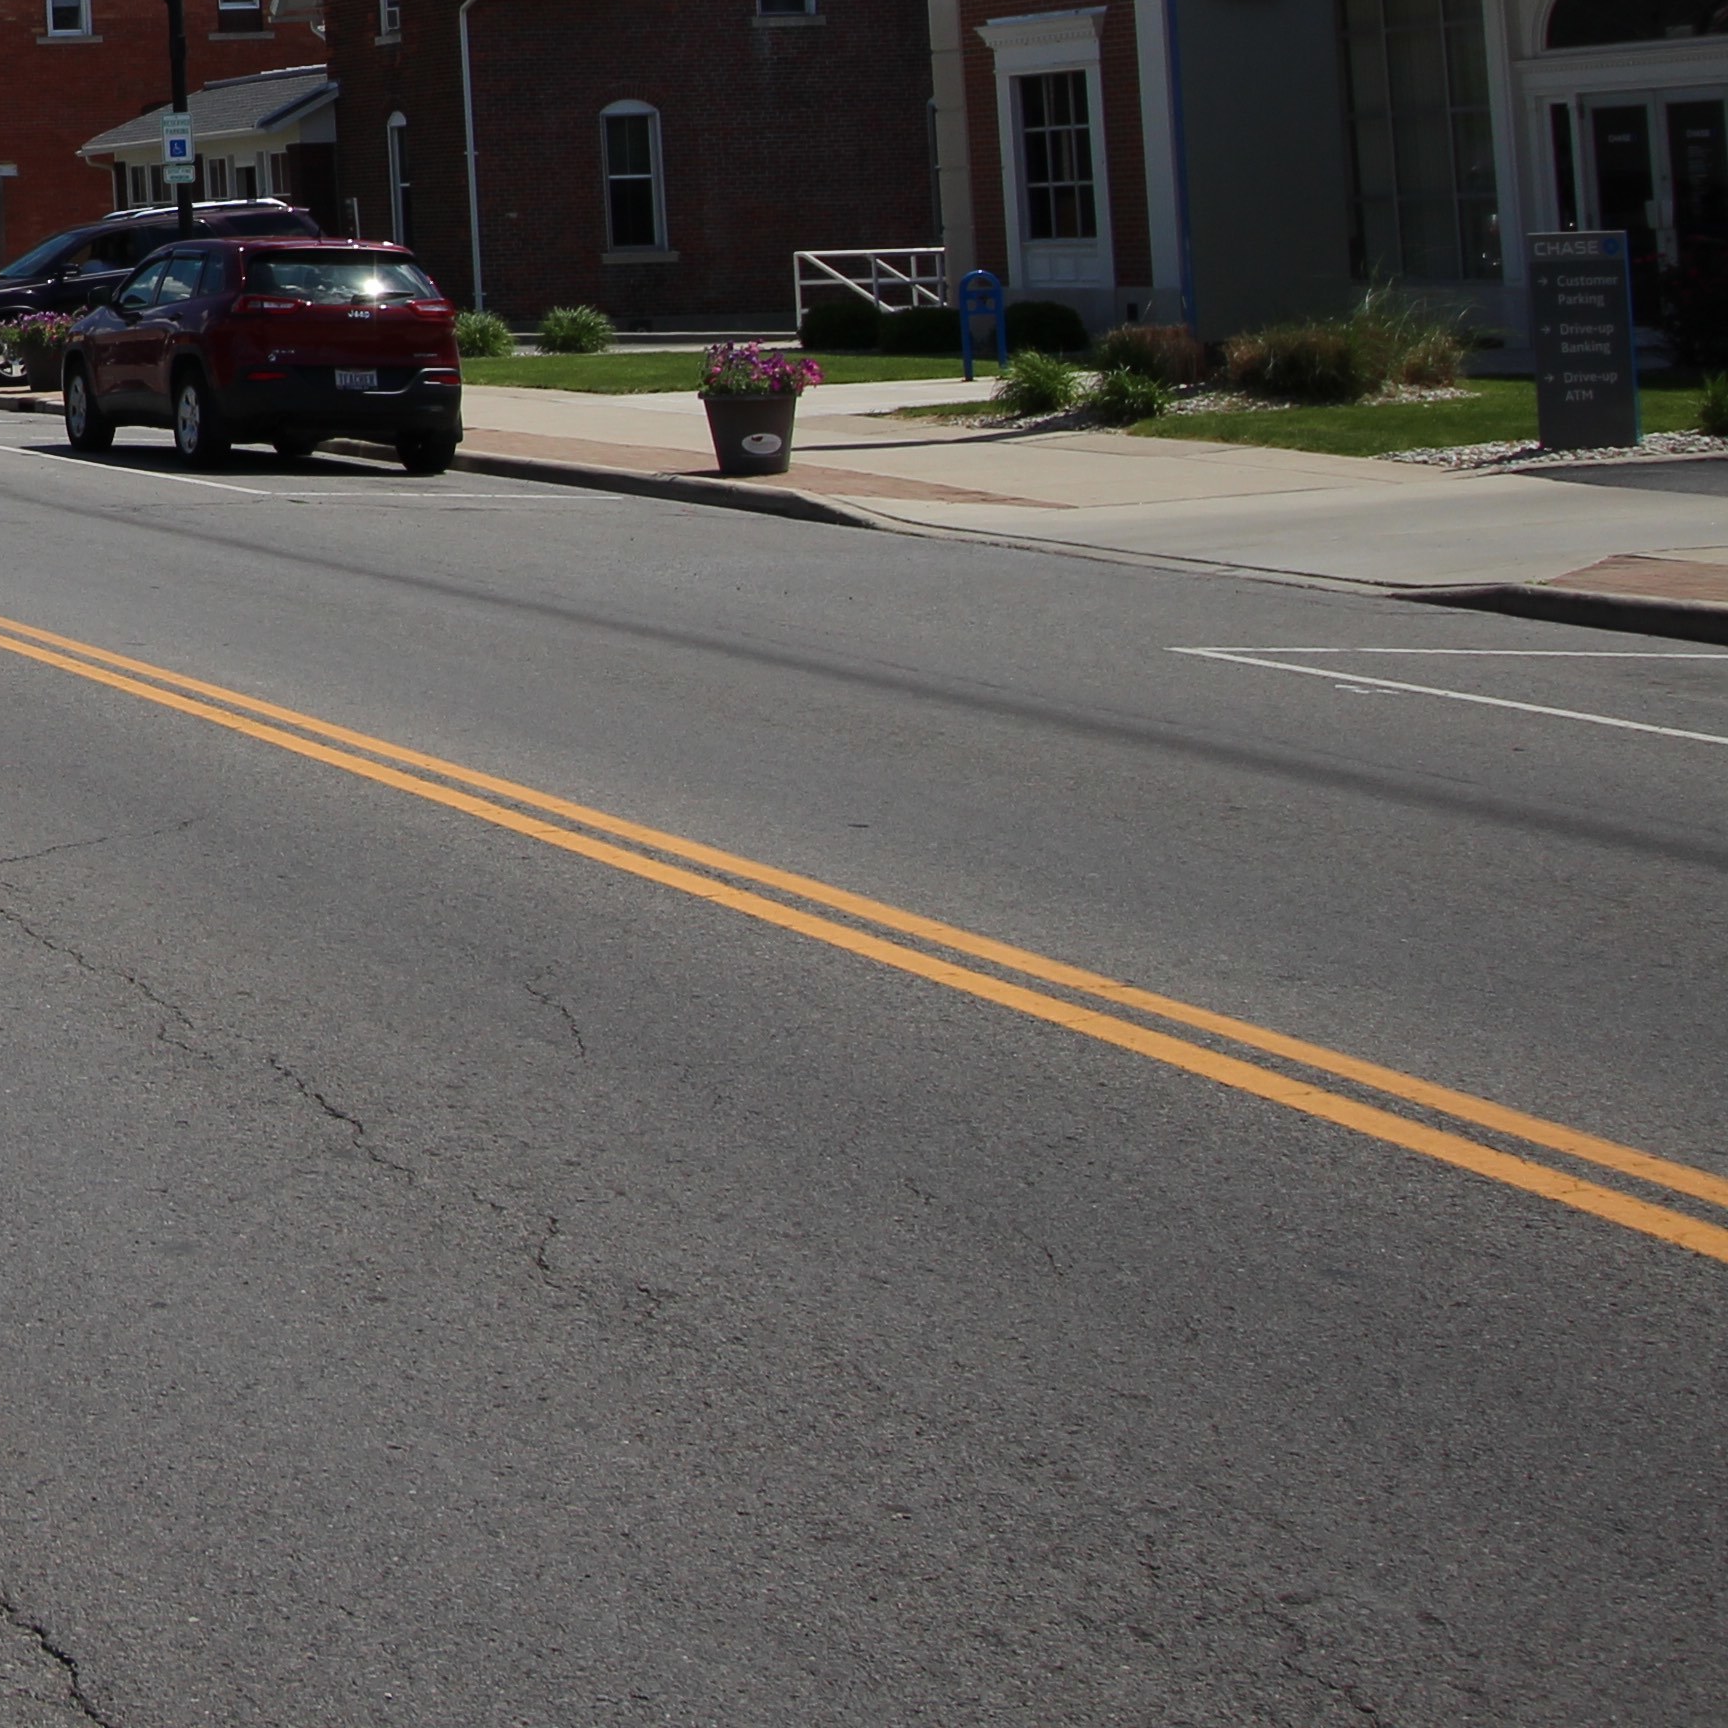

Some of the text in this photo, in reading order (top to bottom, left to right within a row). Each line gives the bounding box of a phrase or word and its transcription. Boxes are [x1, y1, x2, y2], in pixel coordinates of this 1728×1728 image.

[1534, 240, 1600, 256] CHASE
[1556, 275, 1619, 287] Customer
[1558, 294, 1605, 307] Parking
[348, 310, 370, 318] Jeep
[1560, 323, 1614, 337] Drive-up
[1561, 341, 1612, 355] Banking
[1563, 371, 1618, 384] Drive-up
[1565, 389, 1594, 402] ATM
